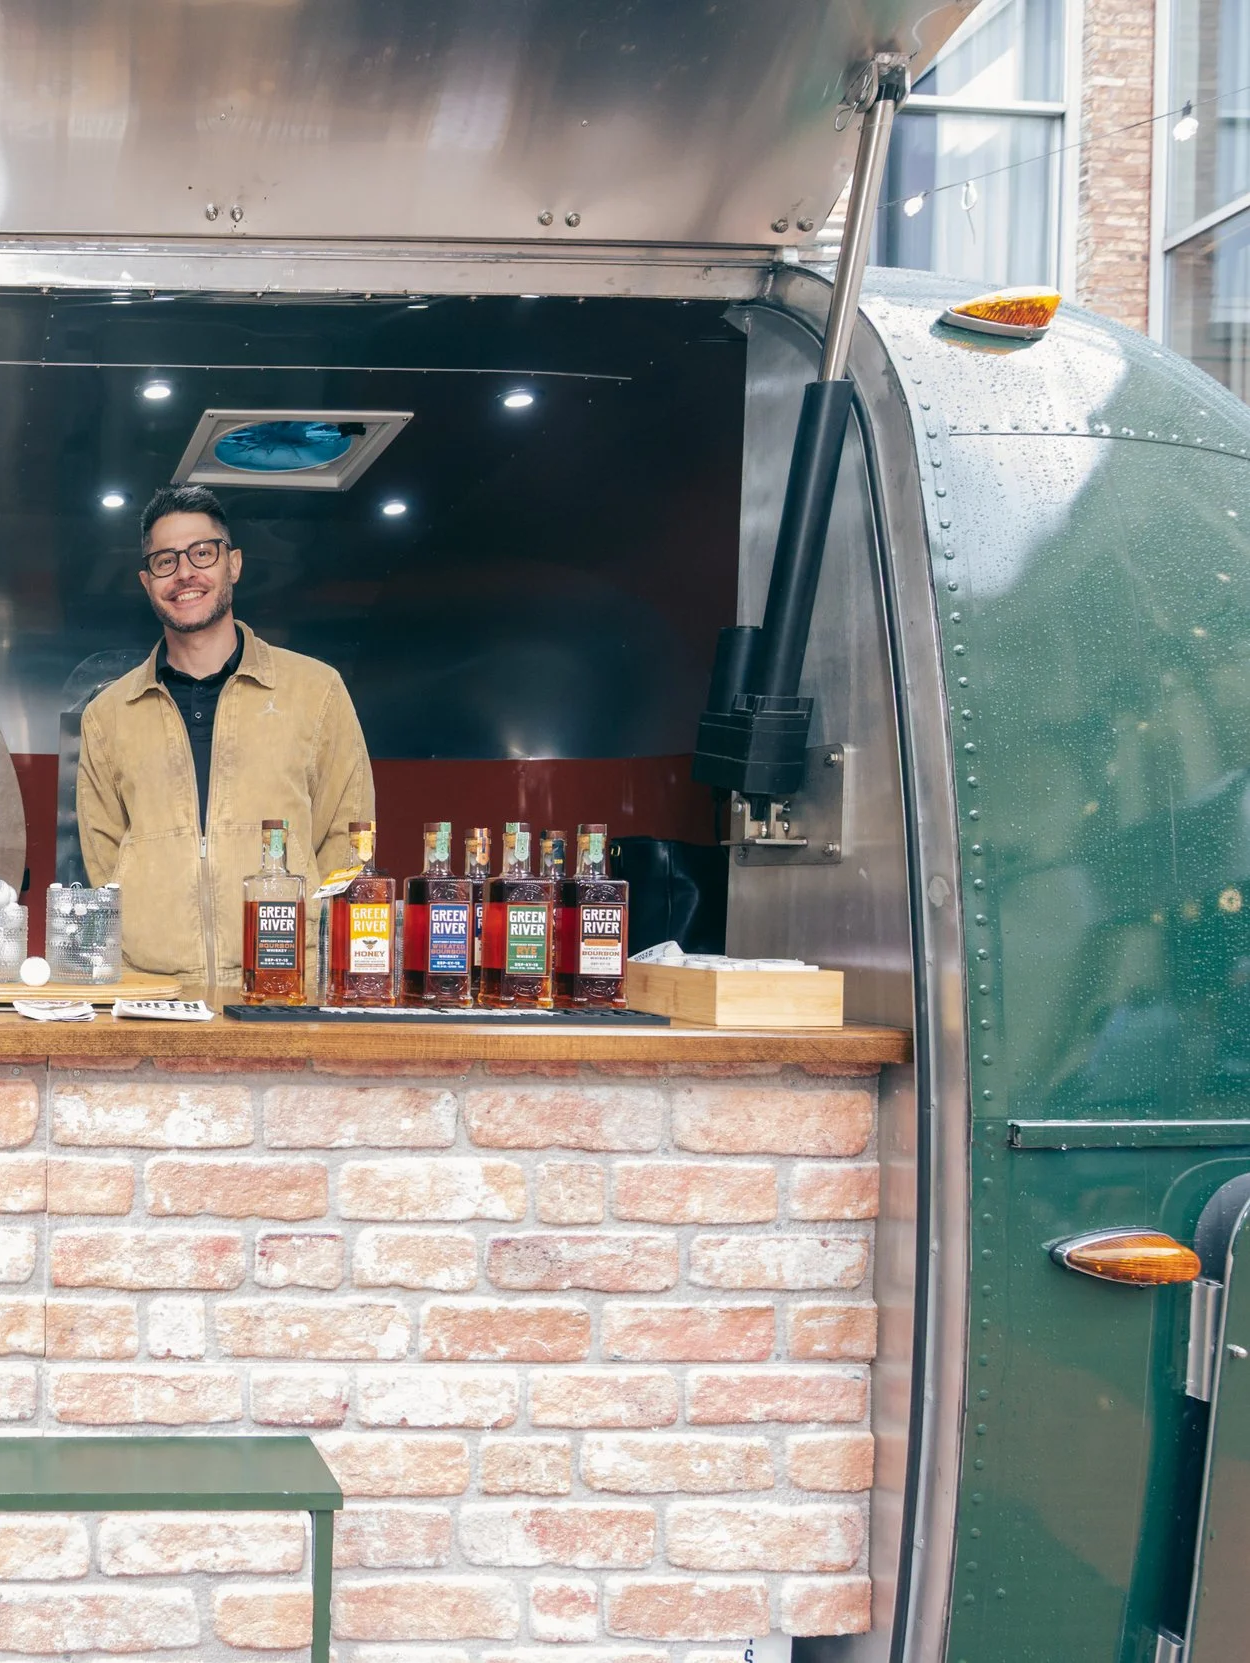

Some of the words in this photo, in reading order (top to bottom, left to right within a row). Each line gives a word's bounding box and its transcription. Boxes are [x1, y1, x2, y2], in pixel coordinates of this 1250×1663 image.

[259, 906, 295, 918] GREEN
[353, 908, 388, 919] GREEN
[432, 910, 467, 921] GREEN
[510, 911, 545, 923] GREEN
[583, 909, 620, 921] GREEN
[260, 919, 294, 931] RIVER
[354, 921, 387, 932] RIVER
[433, 923, 465, 934] RIVER
[511, 924, 544, 935] RIVER
[584, 922, 619, 934] RIVER
[516, 946, 537, 955] RYE
